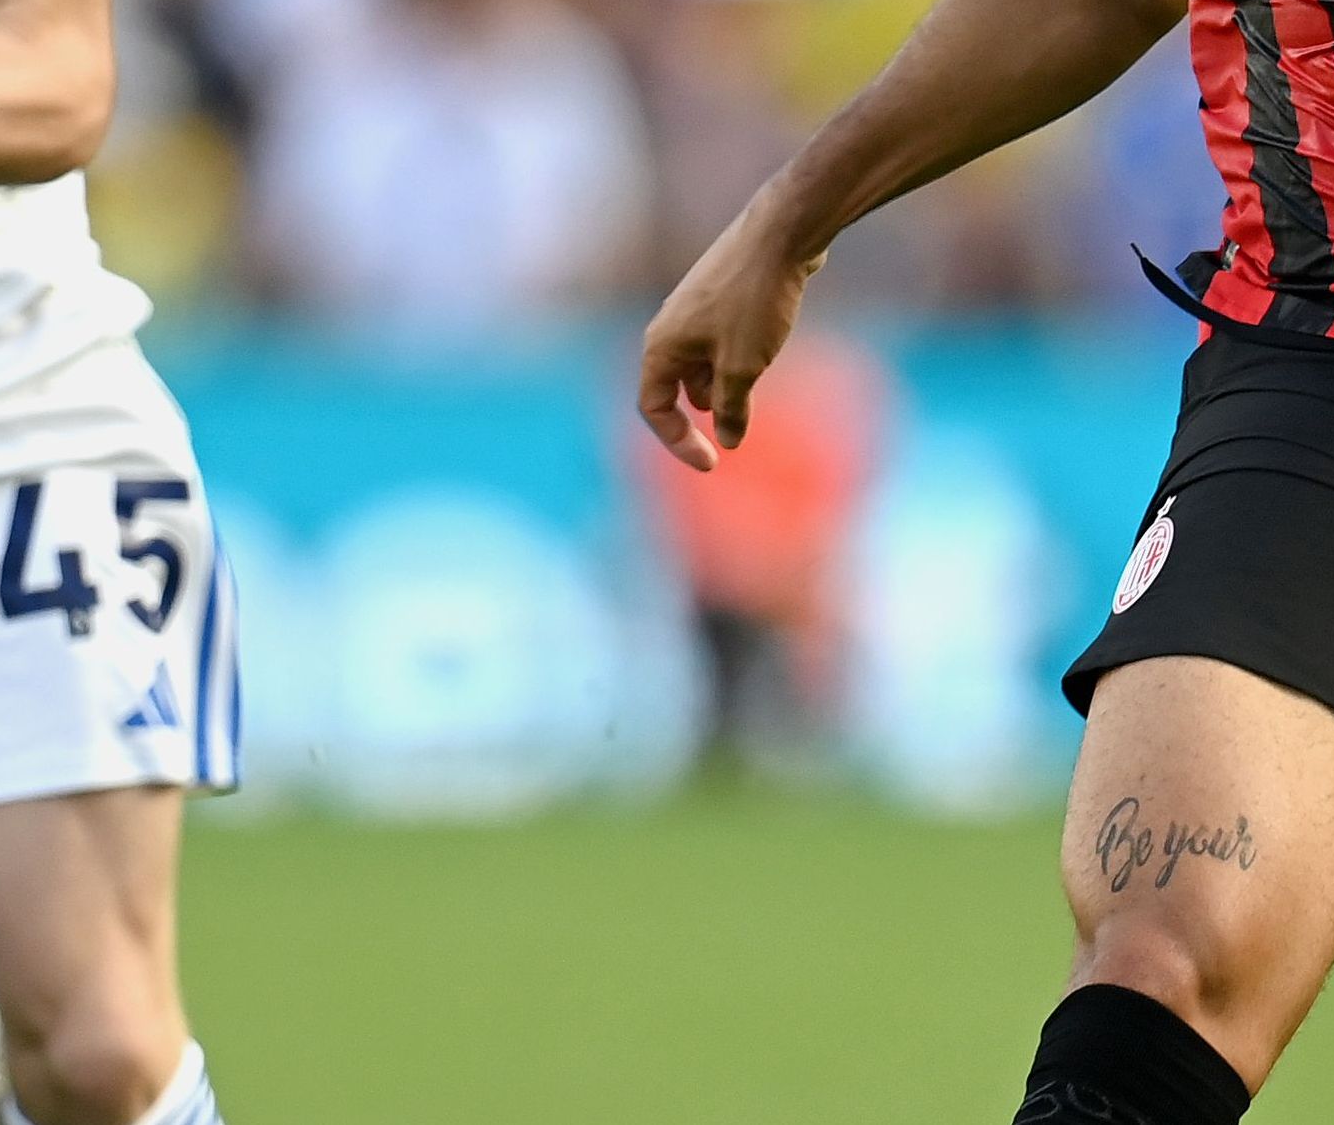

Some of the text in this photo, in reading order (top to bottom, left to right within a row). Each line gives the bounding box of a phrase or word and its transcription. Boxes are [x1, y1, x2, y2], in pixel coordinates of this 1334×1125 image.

[0, 479, 191, 637] 45
[1096, 797, 1258, 894] Be your
